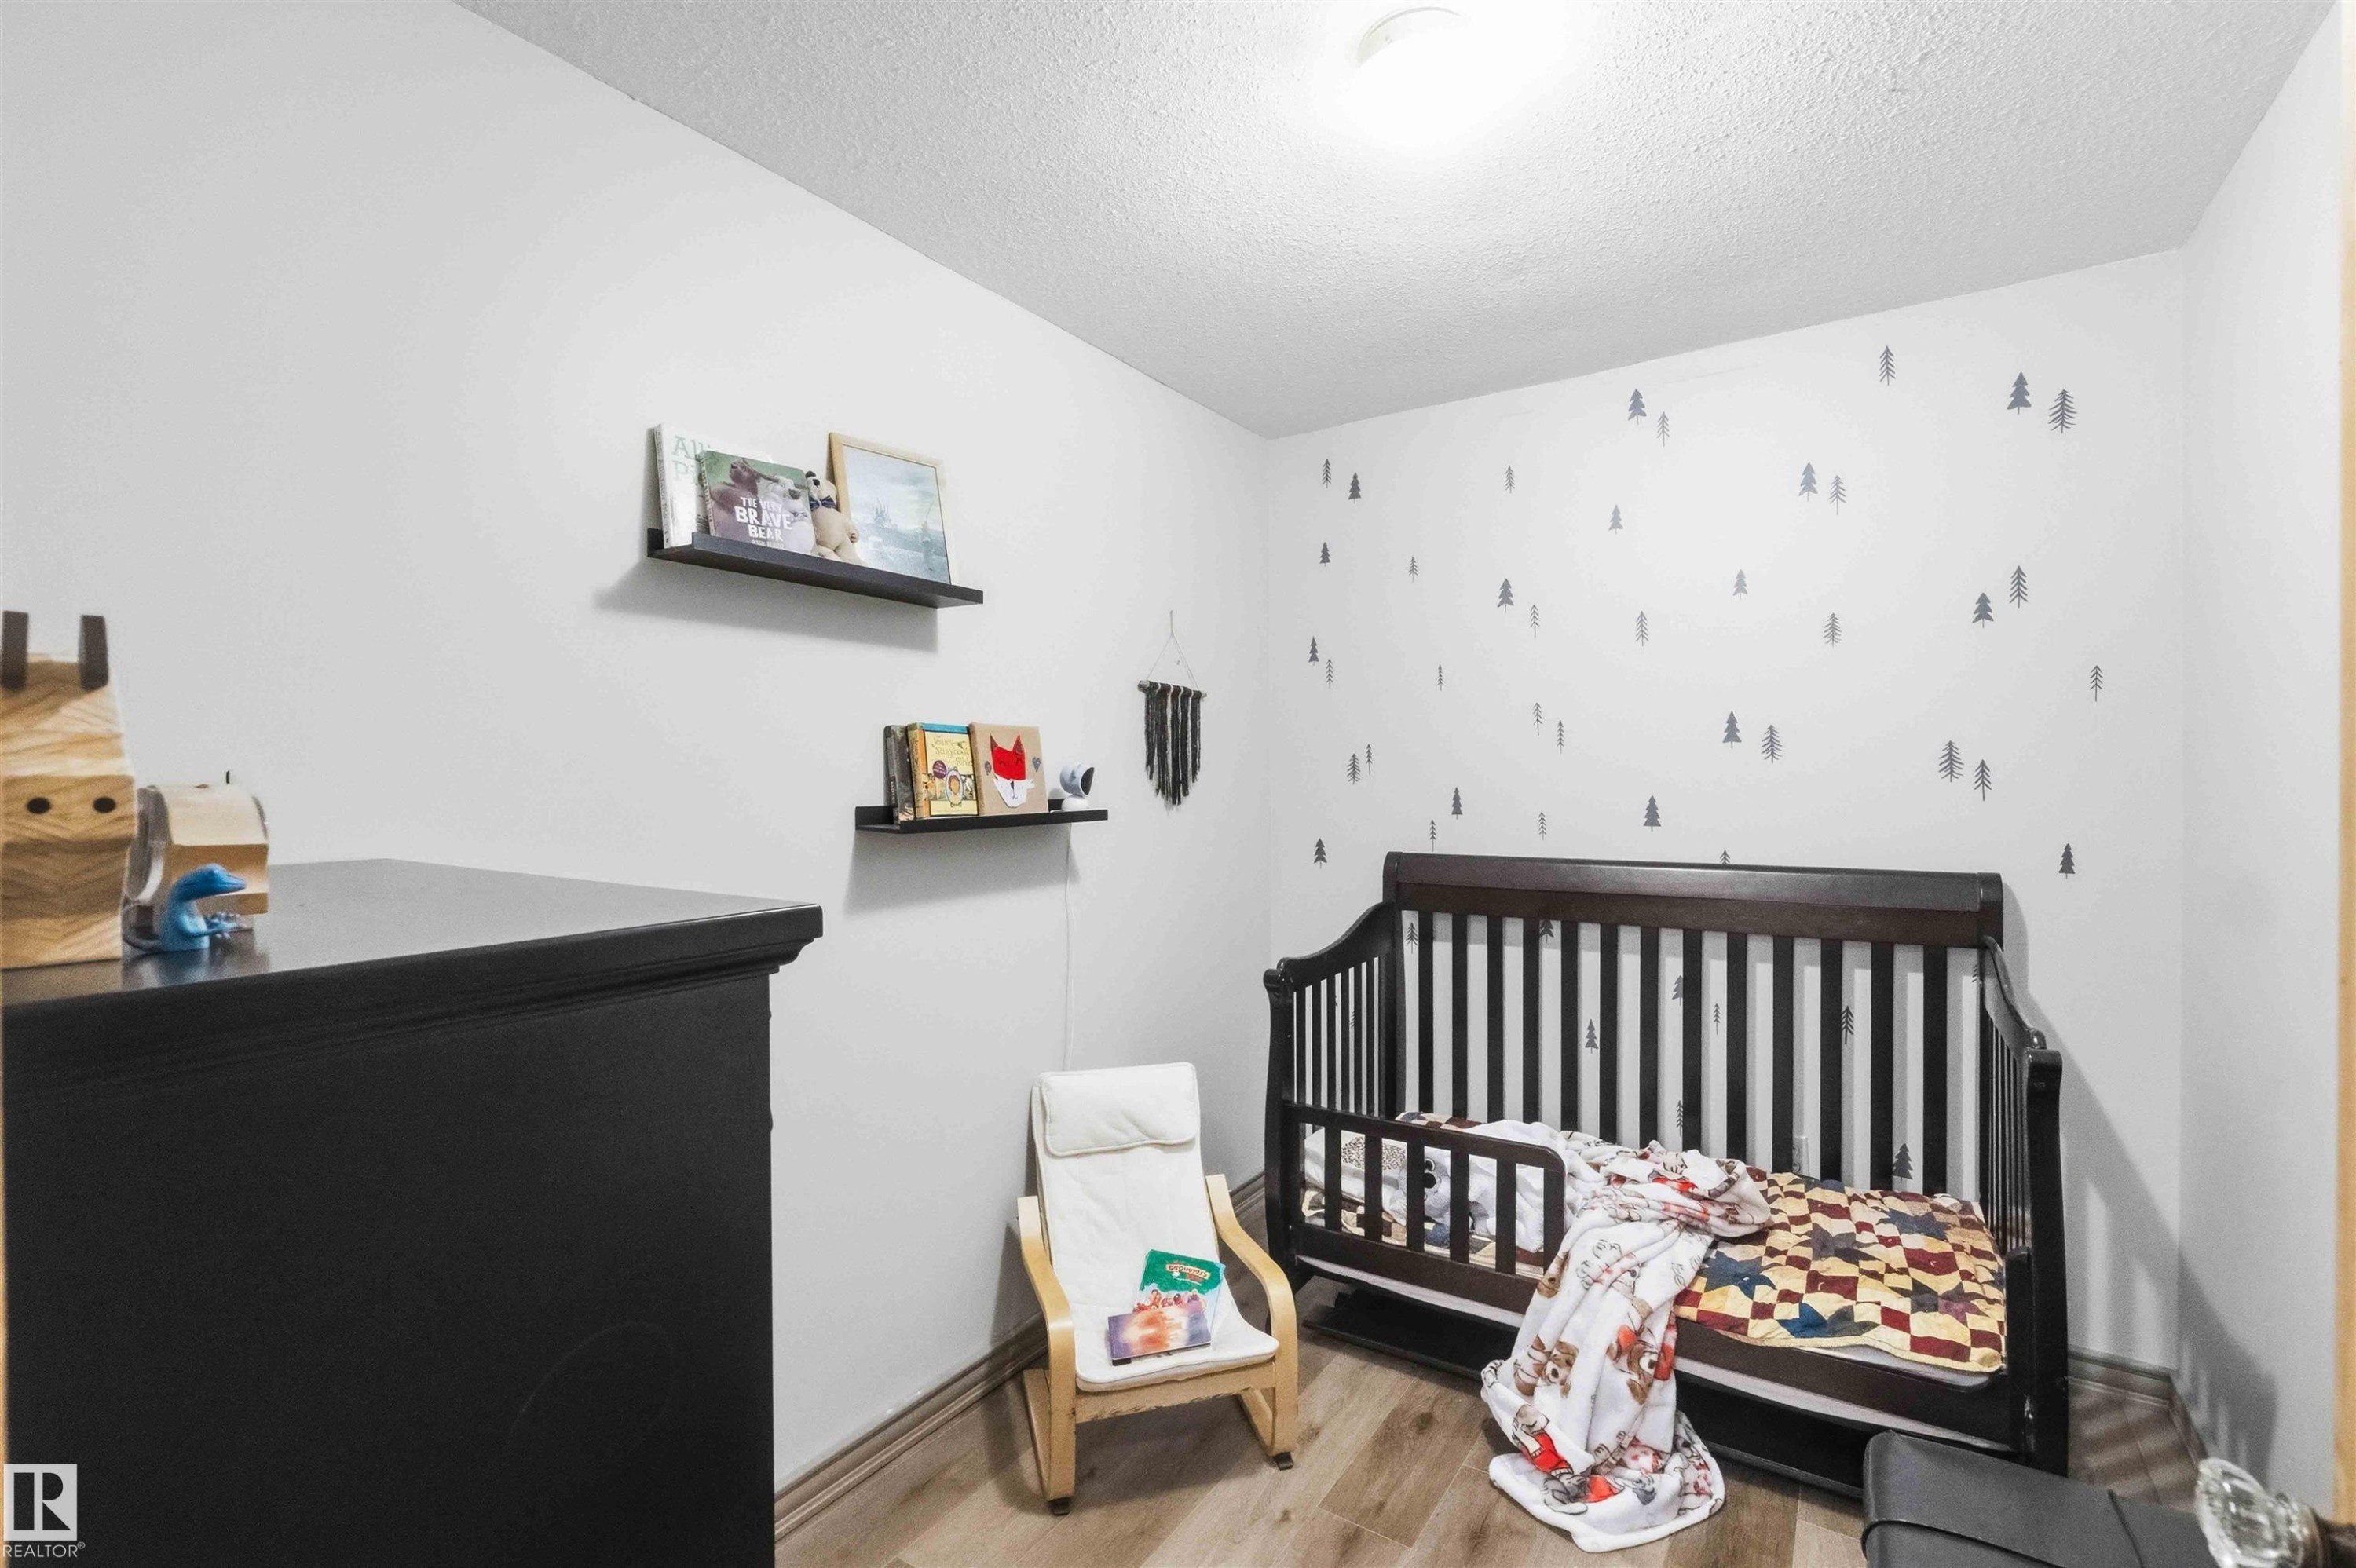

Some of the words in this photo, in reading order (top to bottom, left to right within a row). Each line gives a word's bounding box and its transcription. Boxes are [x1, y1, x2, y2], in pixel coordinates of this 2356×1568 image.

[740, 496, 758, 508] THE
[759, 499, 783, 512] VERY
[734, 505, 792, 530] BRAVE
[748, 524, 784, 542] BEAR
